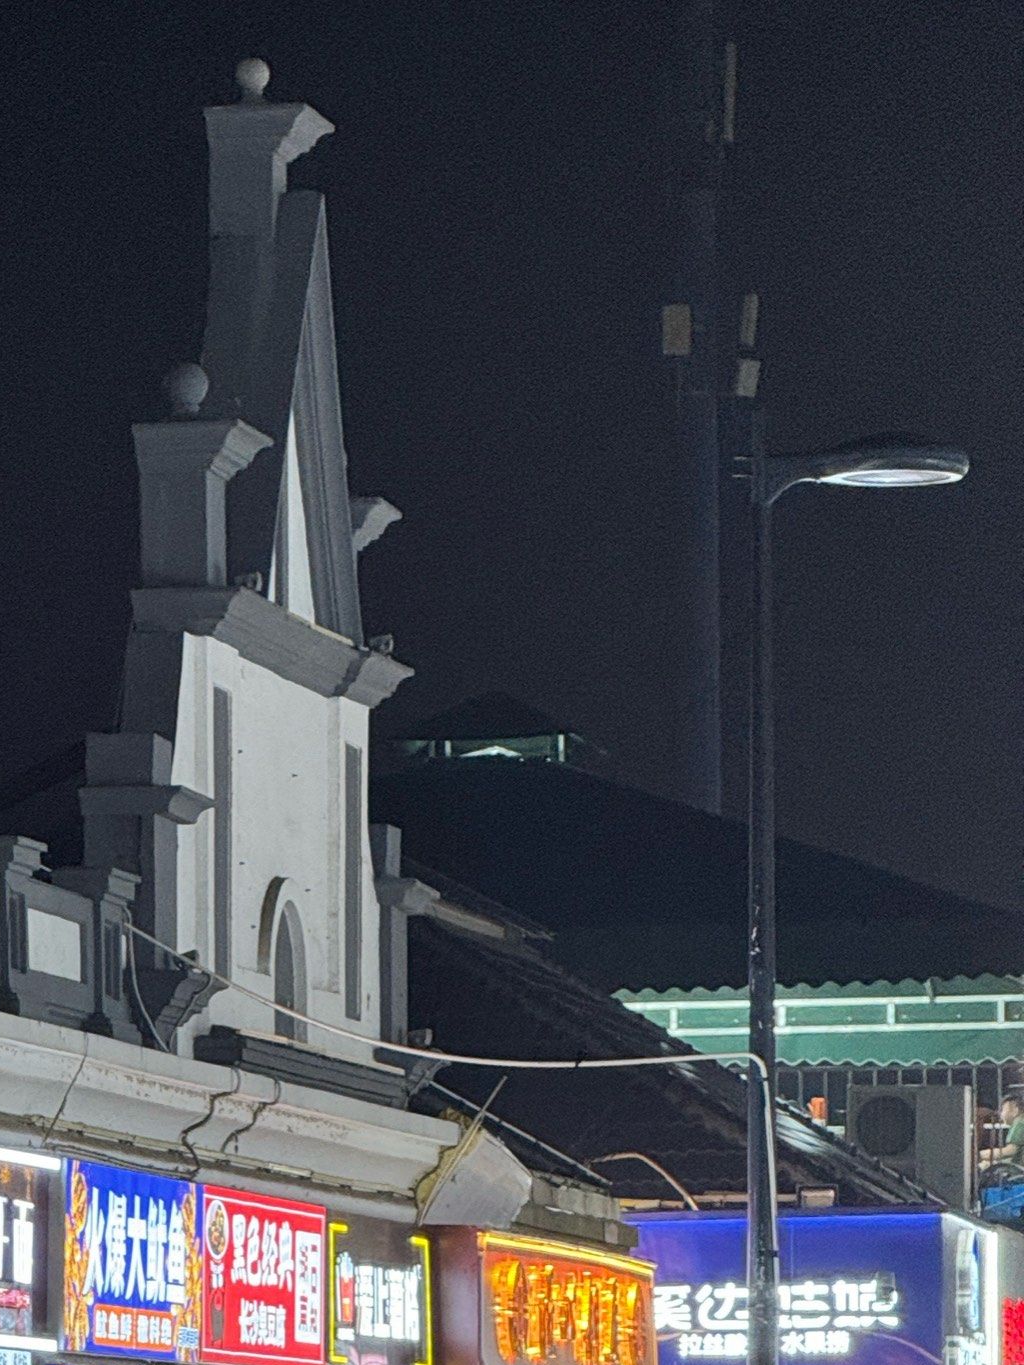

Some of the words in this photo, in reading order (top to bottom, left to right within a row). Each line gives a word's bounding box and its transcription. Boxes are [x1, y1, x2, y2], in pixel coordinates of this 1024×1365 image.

[82, 1186, 188, 1306] 火爆大鱿鱼
[231, 1214, 294, 1292] 黑色经典
